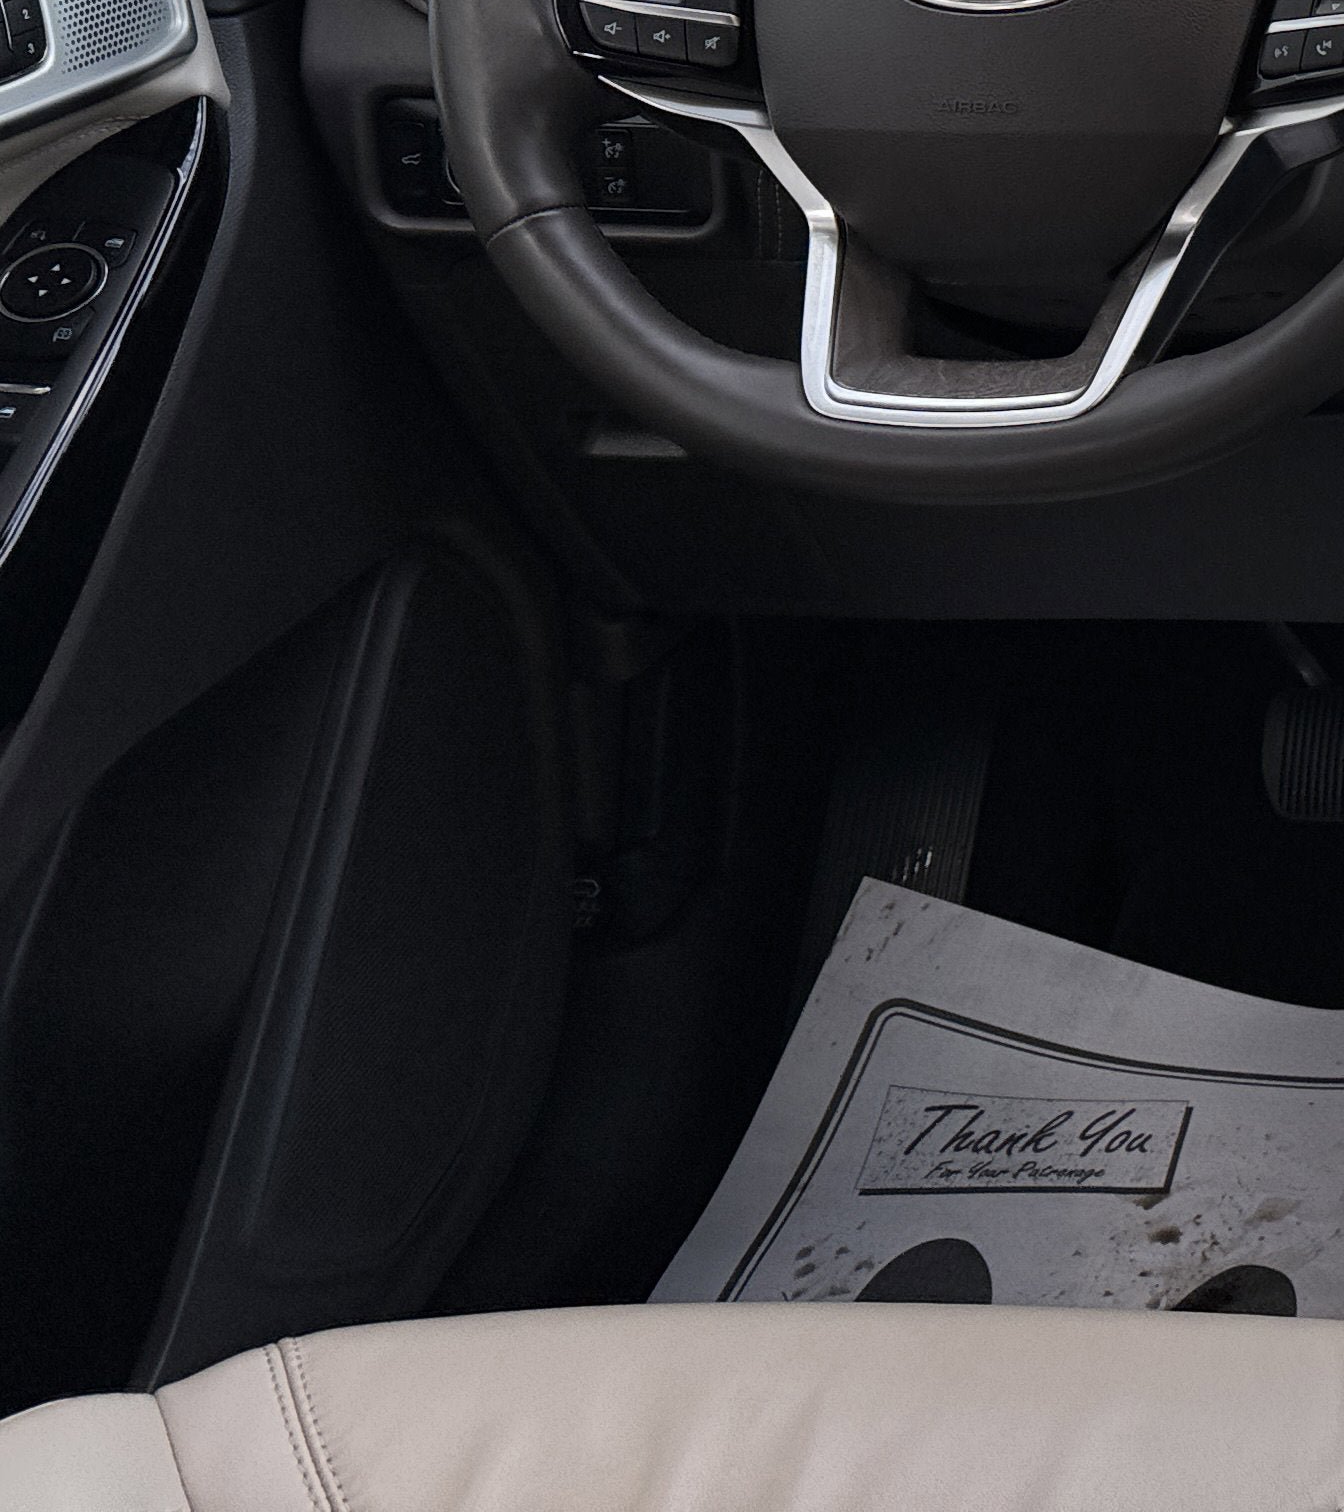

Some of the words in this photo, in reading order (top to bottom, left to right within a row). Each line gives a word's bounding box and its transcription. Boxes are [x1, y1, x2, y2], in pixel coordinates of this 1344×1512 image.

[22, 8, 31, 20] 2
[25, 42, 35, 55] 3
[904, 1103, 1075, 1157] Thank
[1079, 1107, 1154, 1158] You
[924, 1160, 962, 1180] For
[967, 1160, 1010, 1180] Your
[1012, 1160, 1106, 1185] Patronage
